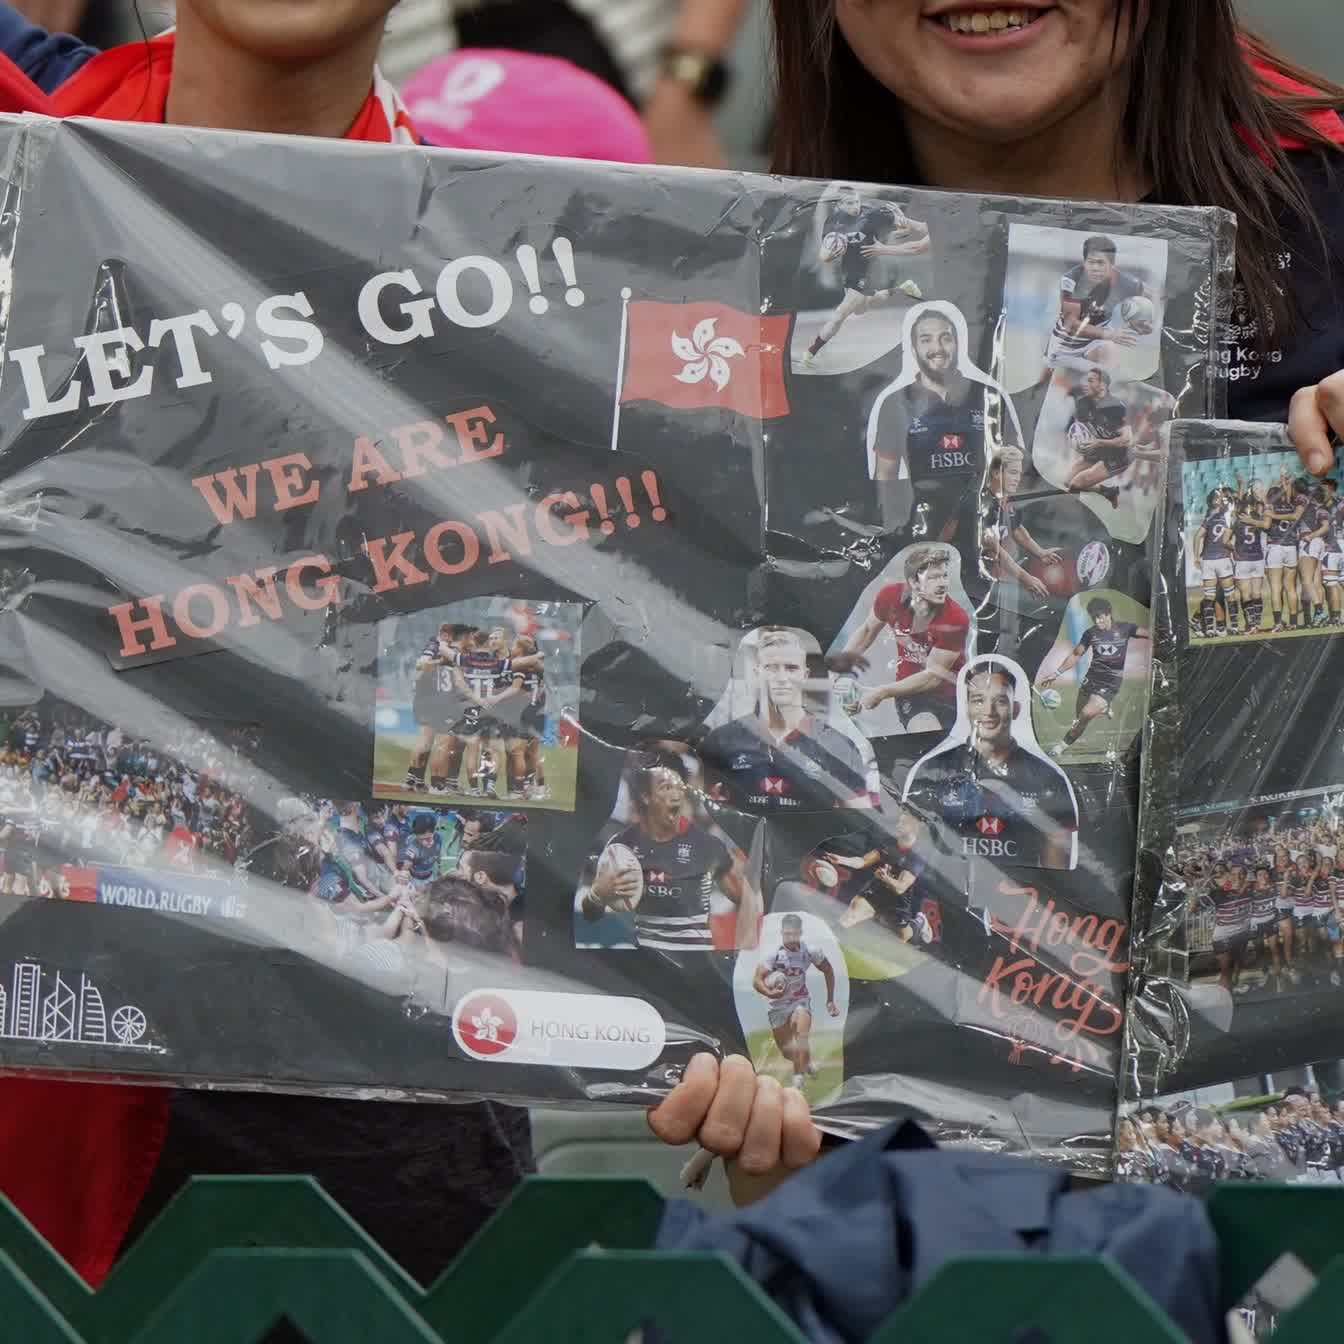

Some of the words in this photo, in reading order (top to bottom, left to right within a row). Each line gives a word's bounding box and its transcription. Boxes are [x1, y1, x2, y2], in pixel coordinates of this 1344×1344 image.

[9, 291, 325, 421] LET'S
[357, 236, 586, 346] GO!!
[192, 452, 321, 527] WE
[347, 406, 506, 493] ARE
[109, 554, 343, 658] HONG
[365, 470, 668, 595] KONG!!!
[961, 837, 1017, 857] HSBC
[100, 883, 212, 917] WORLD.RUGBY
[648, 884, 683, 898] SBC
[992, 880, 1130, 974] Hong
[531, 1019, 590, 1040] HONG
[594, 1024, 651, 1043] KONG
[976, 955, 1124, 1036] Kong
